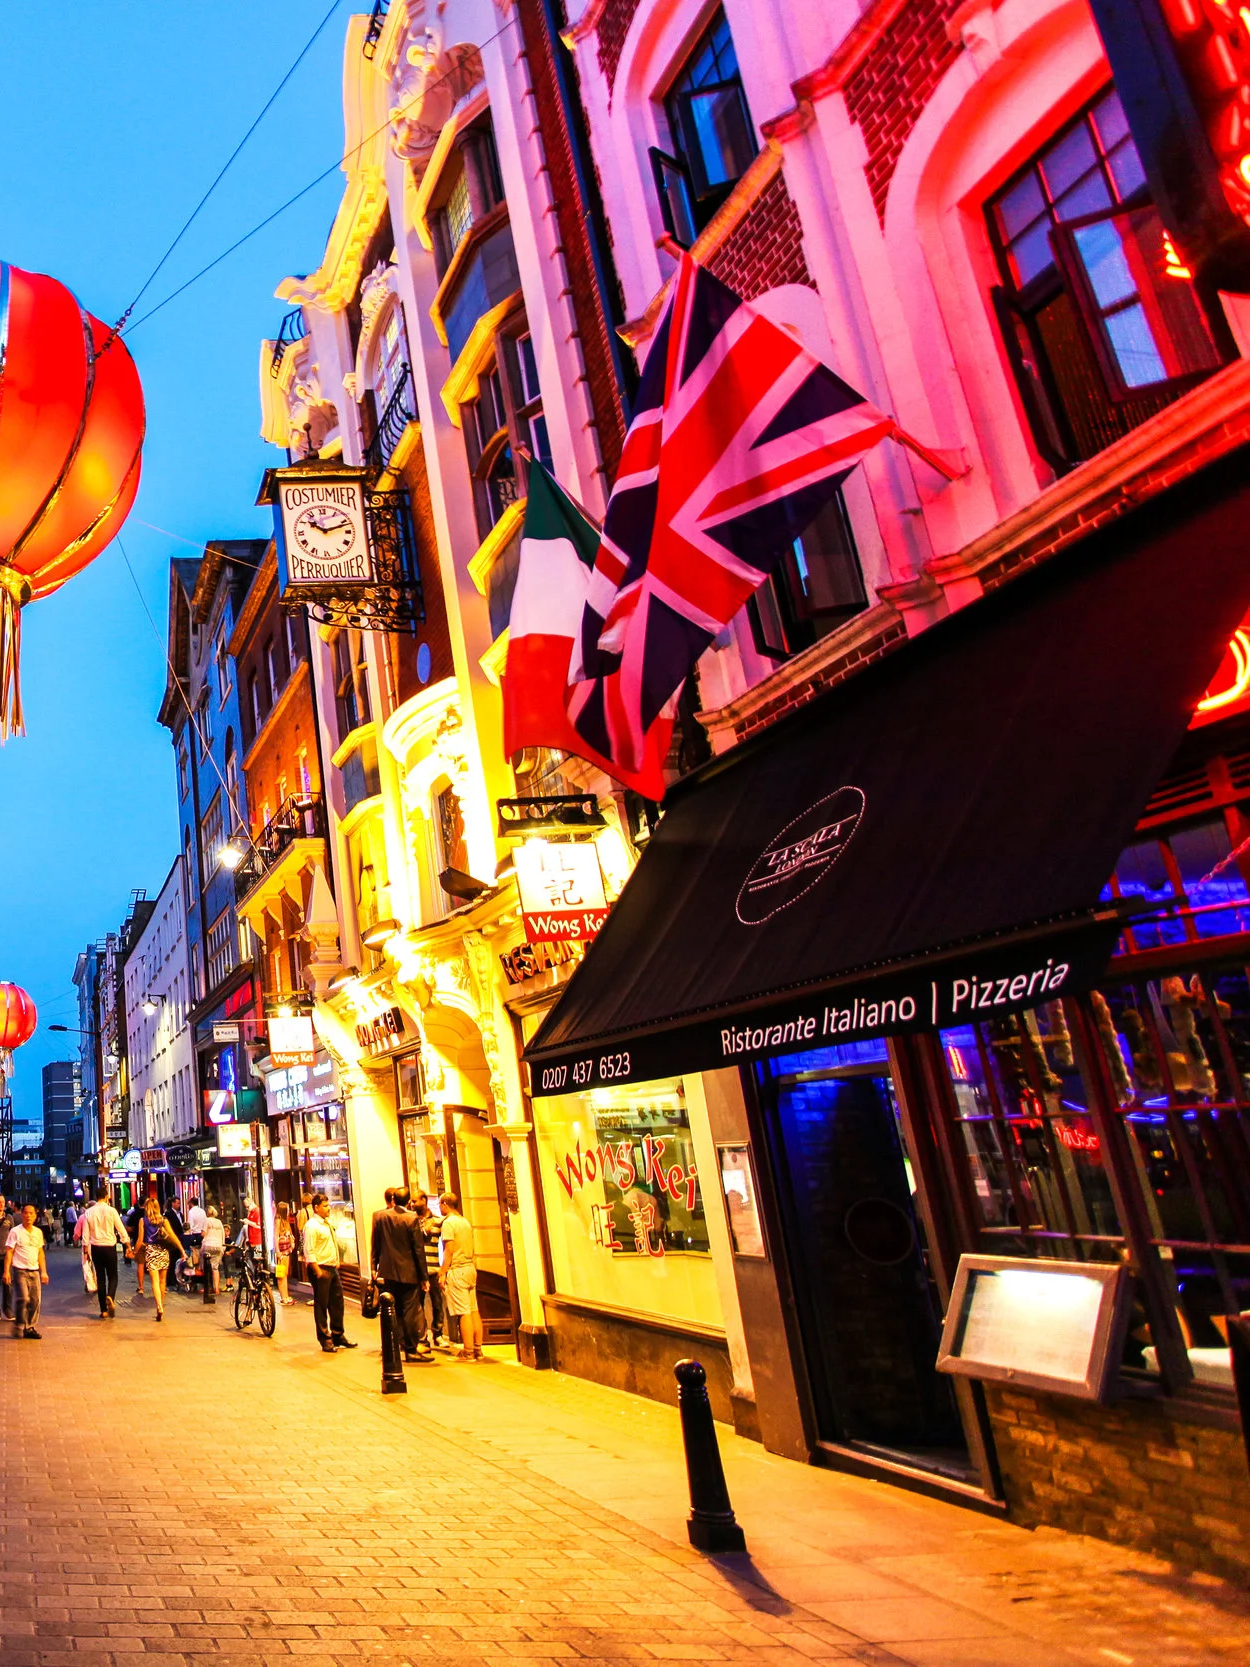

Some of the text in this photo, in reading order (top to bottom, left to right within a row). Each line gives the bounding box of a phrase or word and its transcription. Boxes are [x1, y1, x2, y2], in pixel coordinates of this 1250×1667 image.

[285, 487, 357, 511] COSTUMIER
[291, 554, 366, 579] PERRUQUIER
[528, 913, 608, 937] Wong Ke
[721, 959, 1069, 1055] Ristorante Italiano Pizzeria
[273, 1053, 313, 1064] Wong Kei
[542, 1052, 630, 1089] 0207 437 6523
[555, 1137, 635, 1199] Wong
[643, 1134, 697, 1211] Kei
[591, 1200, 665, 1258] 旺記
